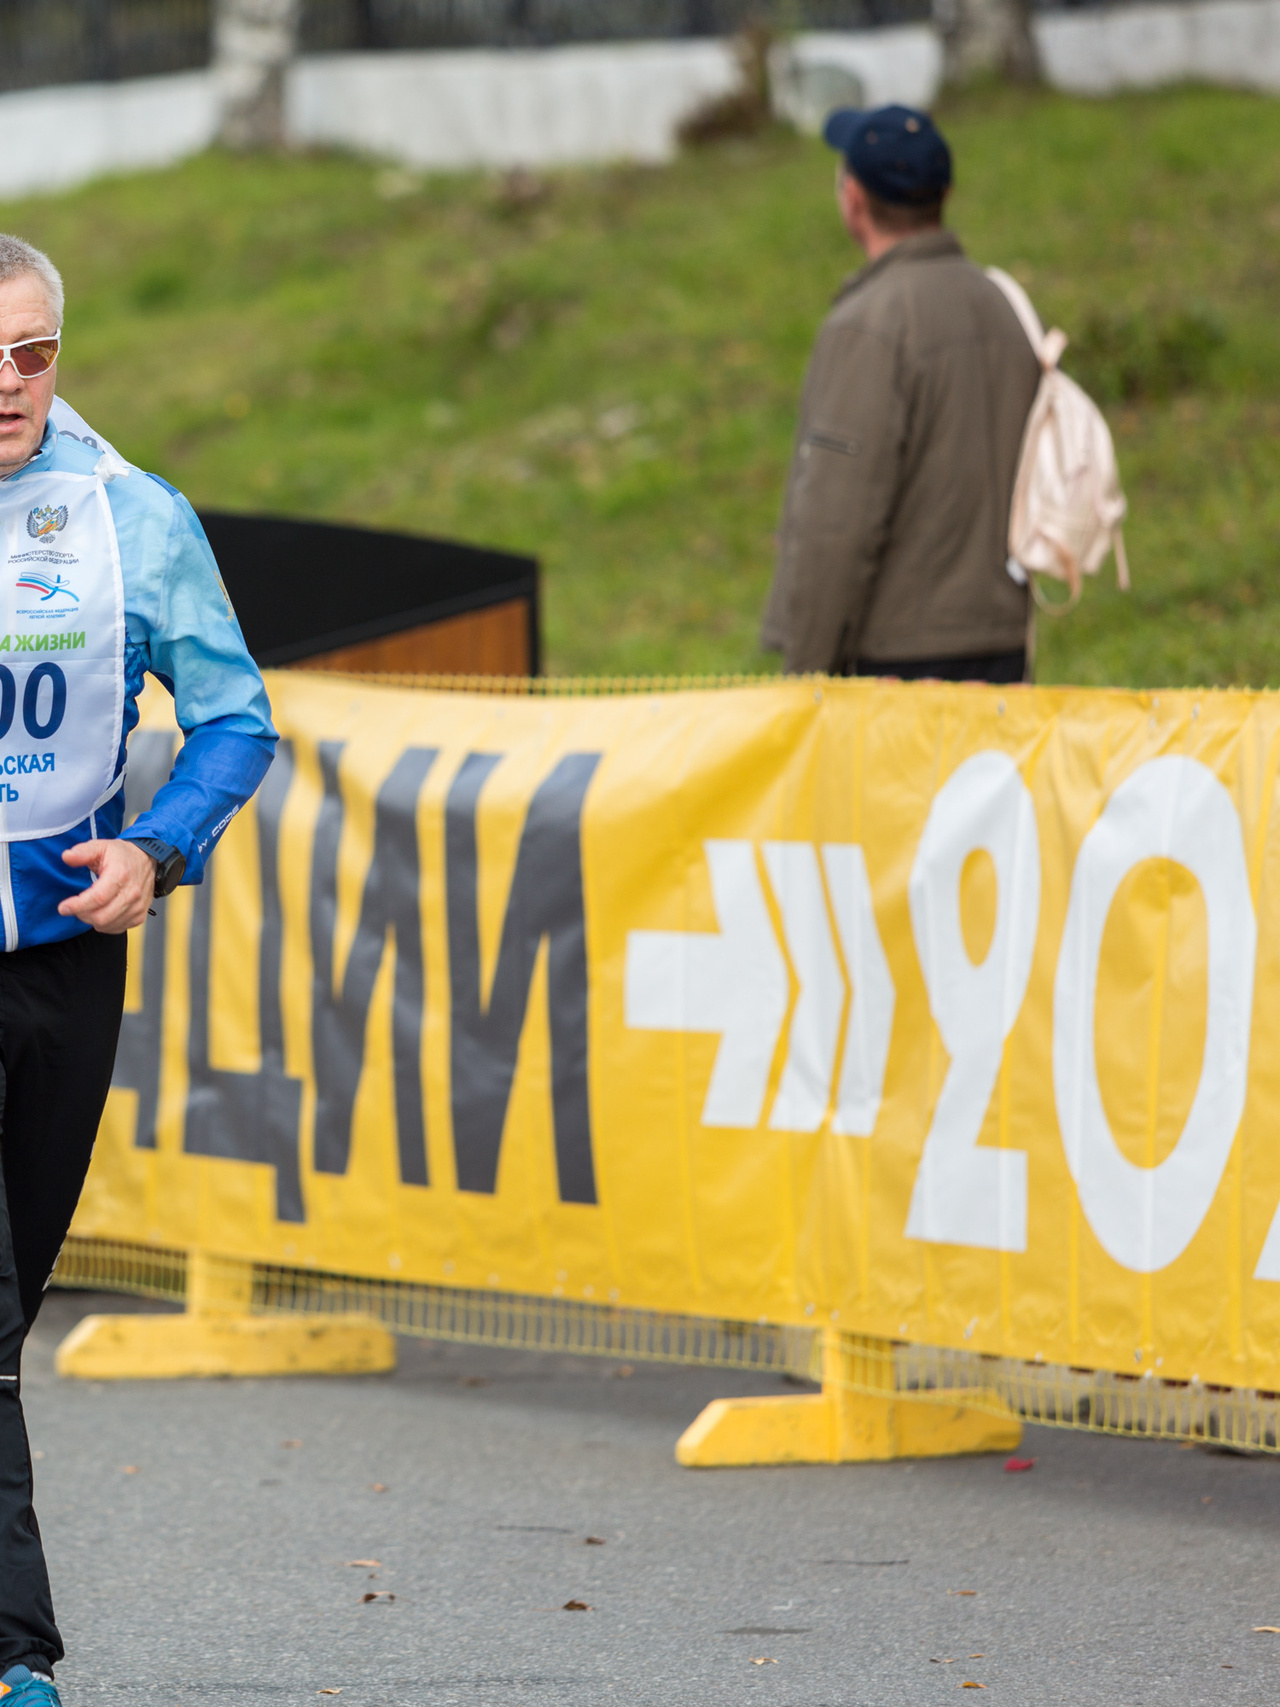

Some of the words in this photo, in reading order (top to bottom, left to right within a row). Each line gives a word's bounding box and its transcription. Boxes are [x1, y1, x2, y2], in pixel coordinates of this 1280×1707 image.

[8, 556, 48, 564] РОССИЙСКОЙ
[49, 557, 79, 565] ФЕДЕРАЦИИ
[14, 631, 86, 652] ЖИЗНИ
[903, 749, 1280, 1281] 20
